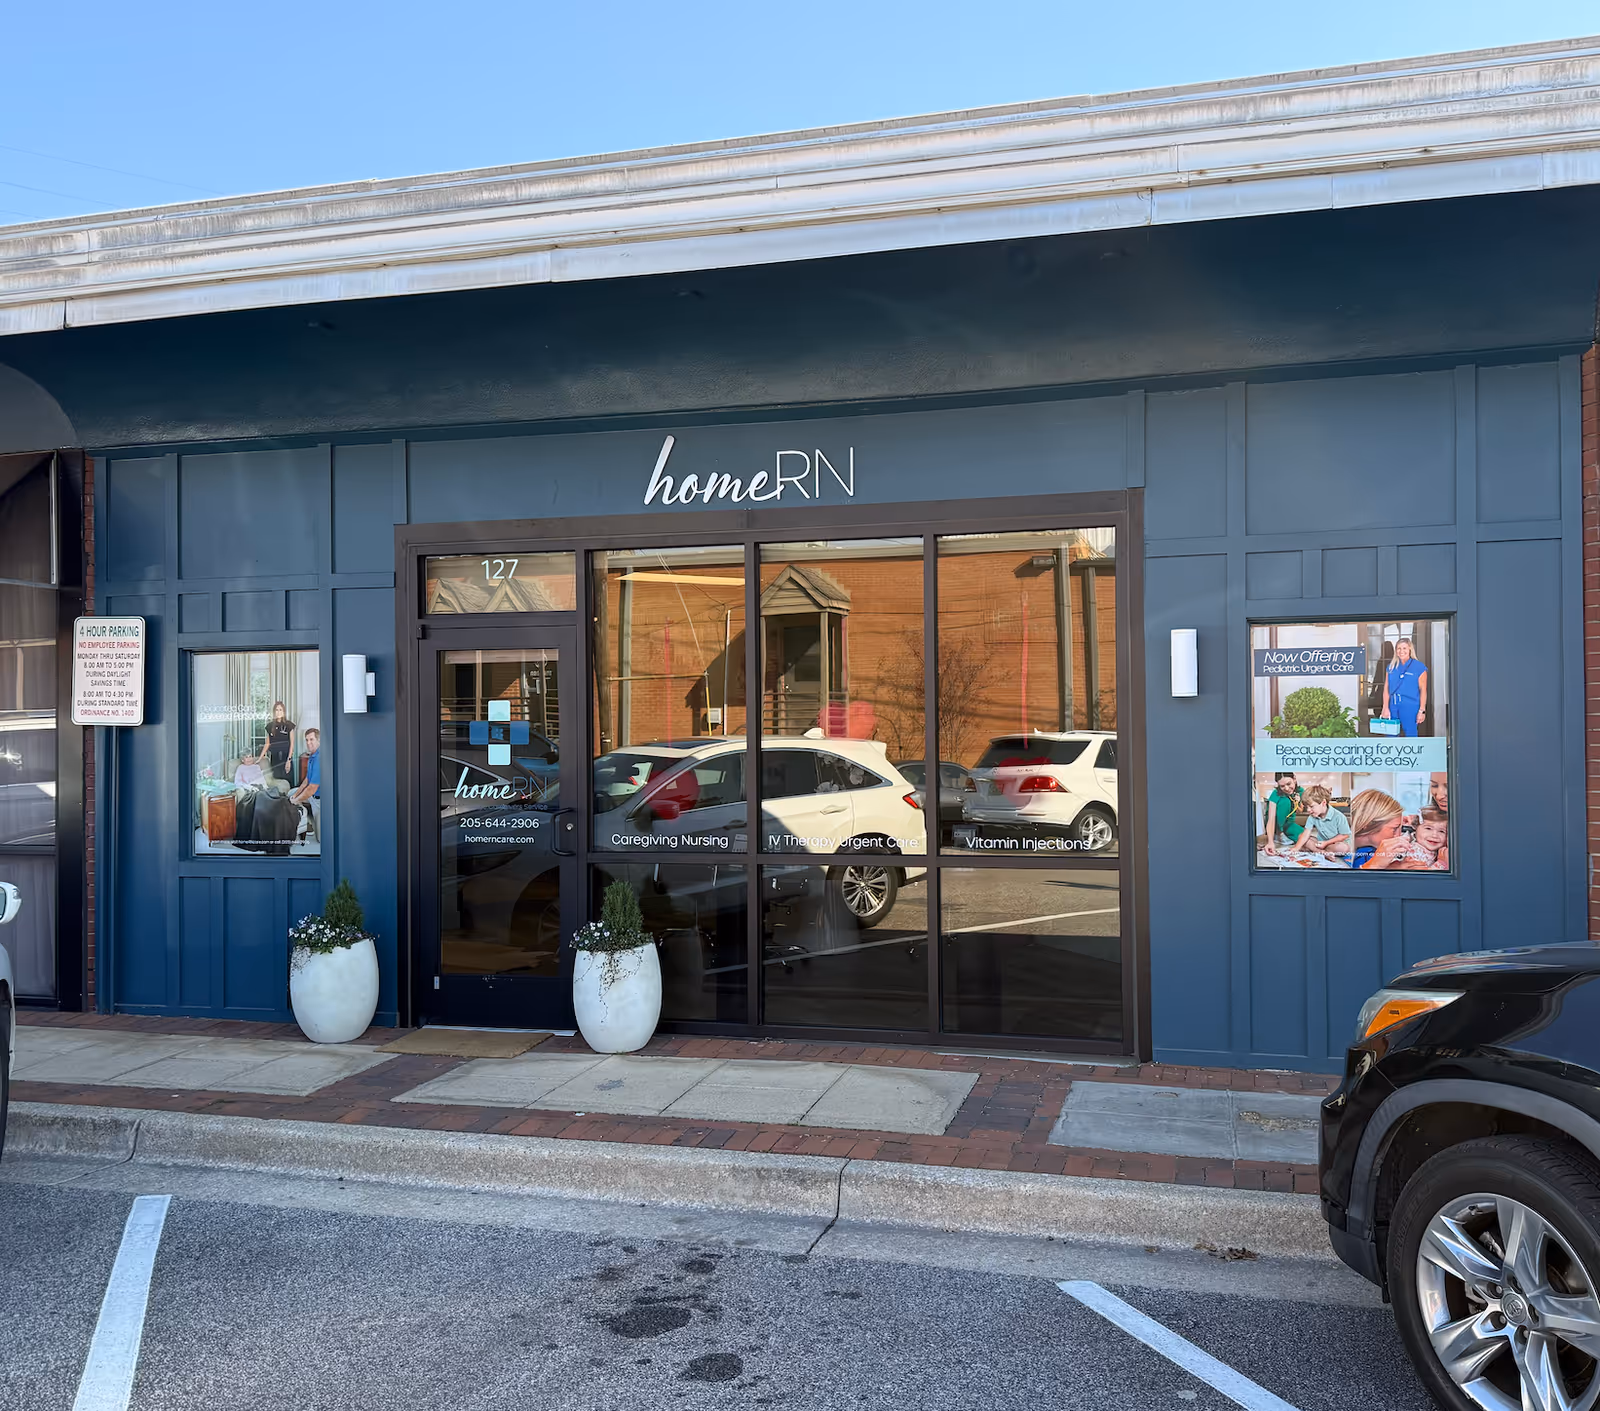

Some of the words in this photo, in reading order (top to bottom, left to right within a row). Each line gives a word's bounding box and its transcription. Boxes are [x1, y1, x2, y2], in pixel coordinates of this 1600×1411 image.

[643, 434, 854, 506] homeRN
[481, 558, 519, 580] 127
[80, 626, 84, 637] 4
[86, 626, 106, 637] HOUR
[108, 626, 139, 637] PARKING
[1264, 651, 1298, 664] Now
[1300, 650, 1355, 664] Offering
[1263, 664, 1300, 674] Pediatric
[1301, 664, 1331, 674] Urgent
[1332, 664, 1354, 672] Care
[1276, 744, 1332, 755] Because
[1334, 744, 1374, 758] caring
[1376, 743, 1393, 755] for
[1394, 744, 1424, 758] your
[1281, 755, 1318, 768] family
[1321, 755, 1363, 766] should
[1365, 755, 1383, 766] be
[1385, 756, 1419, 768] easy.
[454, 766, 548, 799] homeRN
[460, 818, 540, 829] 205-644-2906
[464, 835, 534, 844] homerncare.com
[611, 834, 678, 848] Caregiving
[681, 834, 729, 849] Nursing
[768, 835, 781, 846] IV
[783, 834, 836, 849] Therapy
[840, 836, 883, 850] Urgent
[886, 836, 918, 848] Care
[965, 837, 1019, 849] Vitamin
[1022, 837, 1091, 852] Injections
